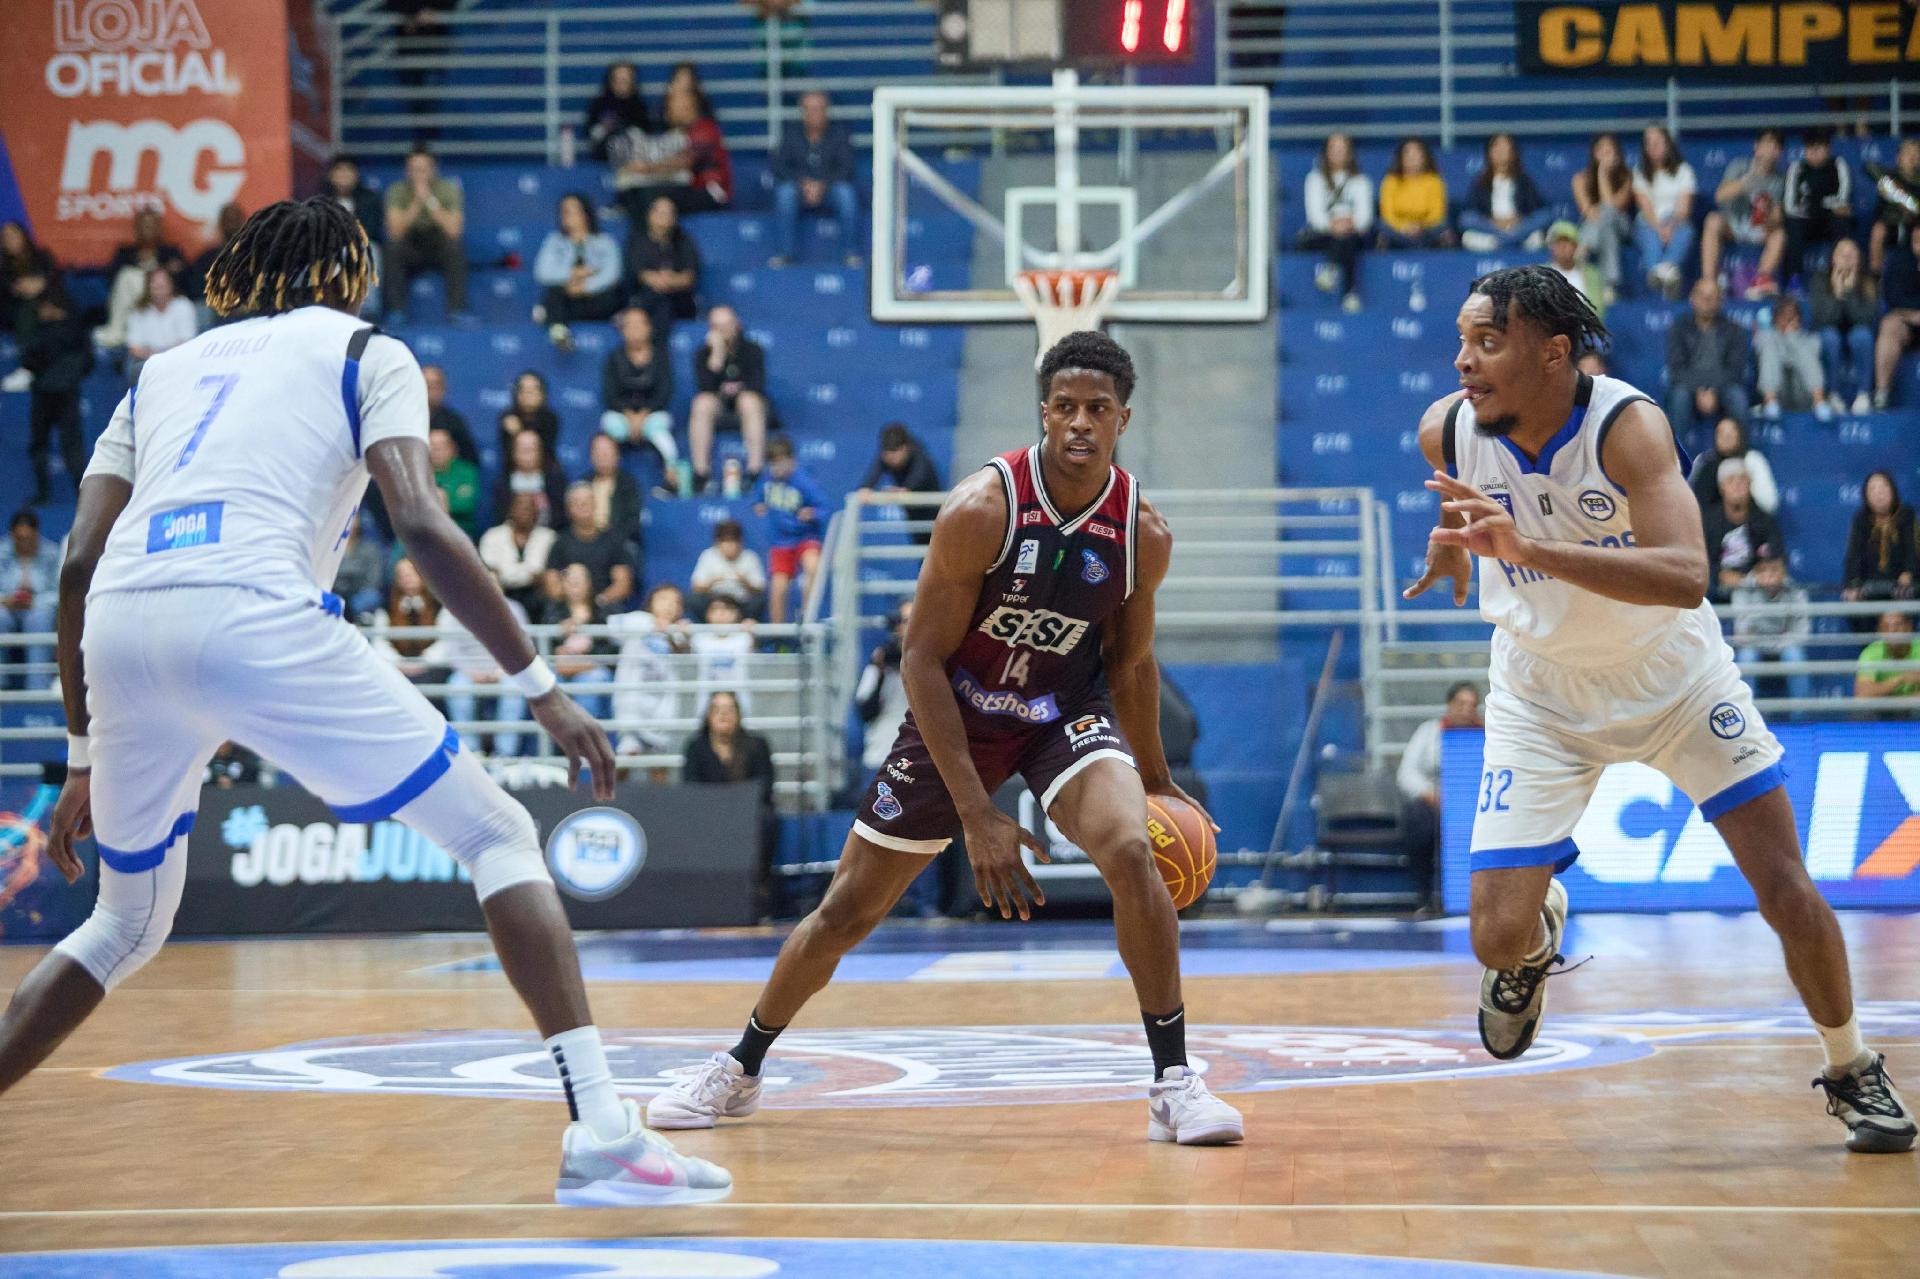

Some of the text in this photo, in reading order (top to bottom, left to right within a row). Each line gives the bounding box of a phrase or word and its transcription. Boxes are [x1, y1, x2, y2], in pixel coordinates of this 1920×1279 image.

[54, 0, 211, 51] LOJA
[46, 49, 241, 97] OFICIAL
[173, 372, 241, 473] 7
[1090, 524, 1114, 536] FIESP
[1002, 593, 1029, 603] Tpper
[992, 612, 1077, 648] SESI
[999, 650, 1032, 688] 14
[1480, 769, 1513, 812] 32
[221, 804, 473, 887] #JOGAJUN
[1147, 819, 1176, 849] PE
